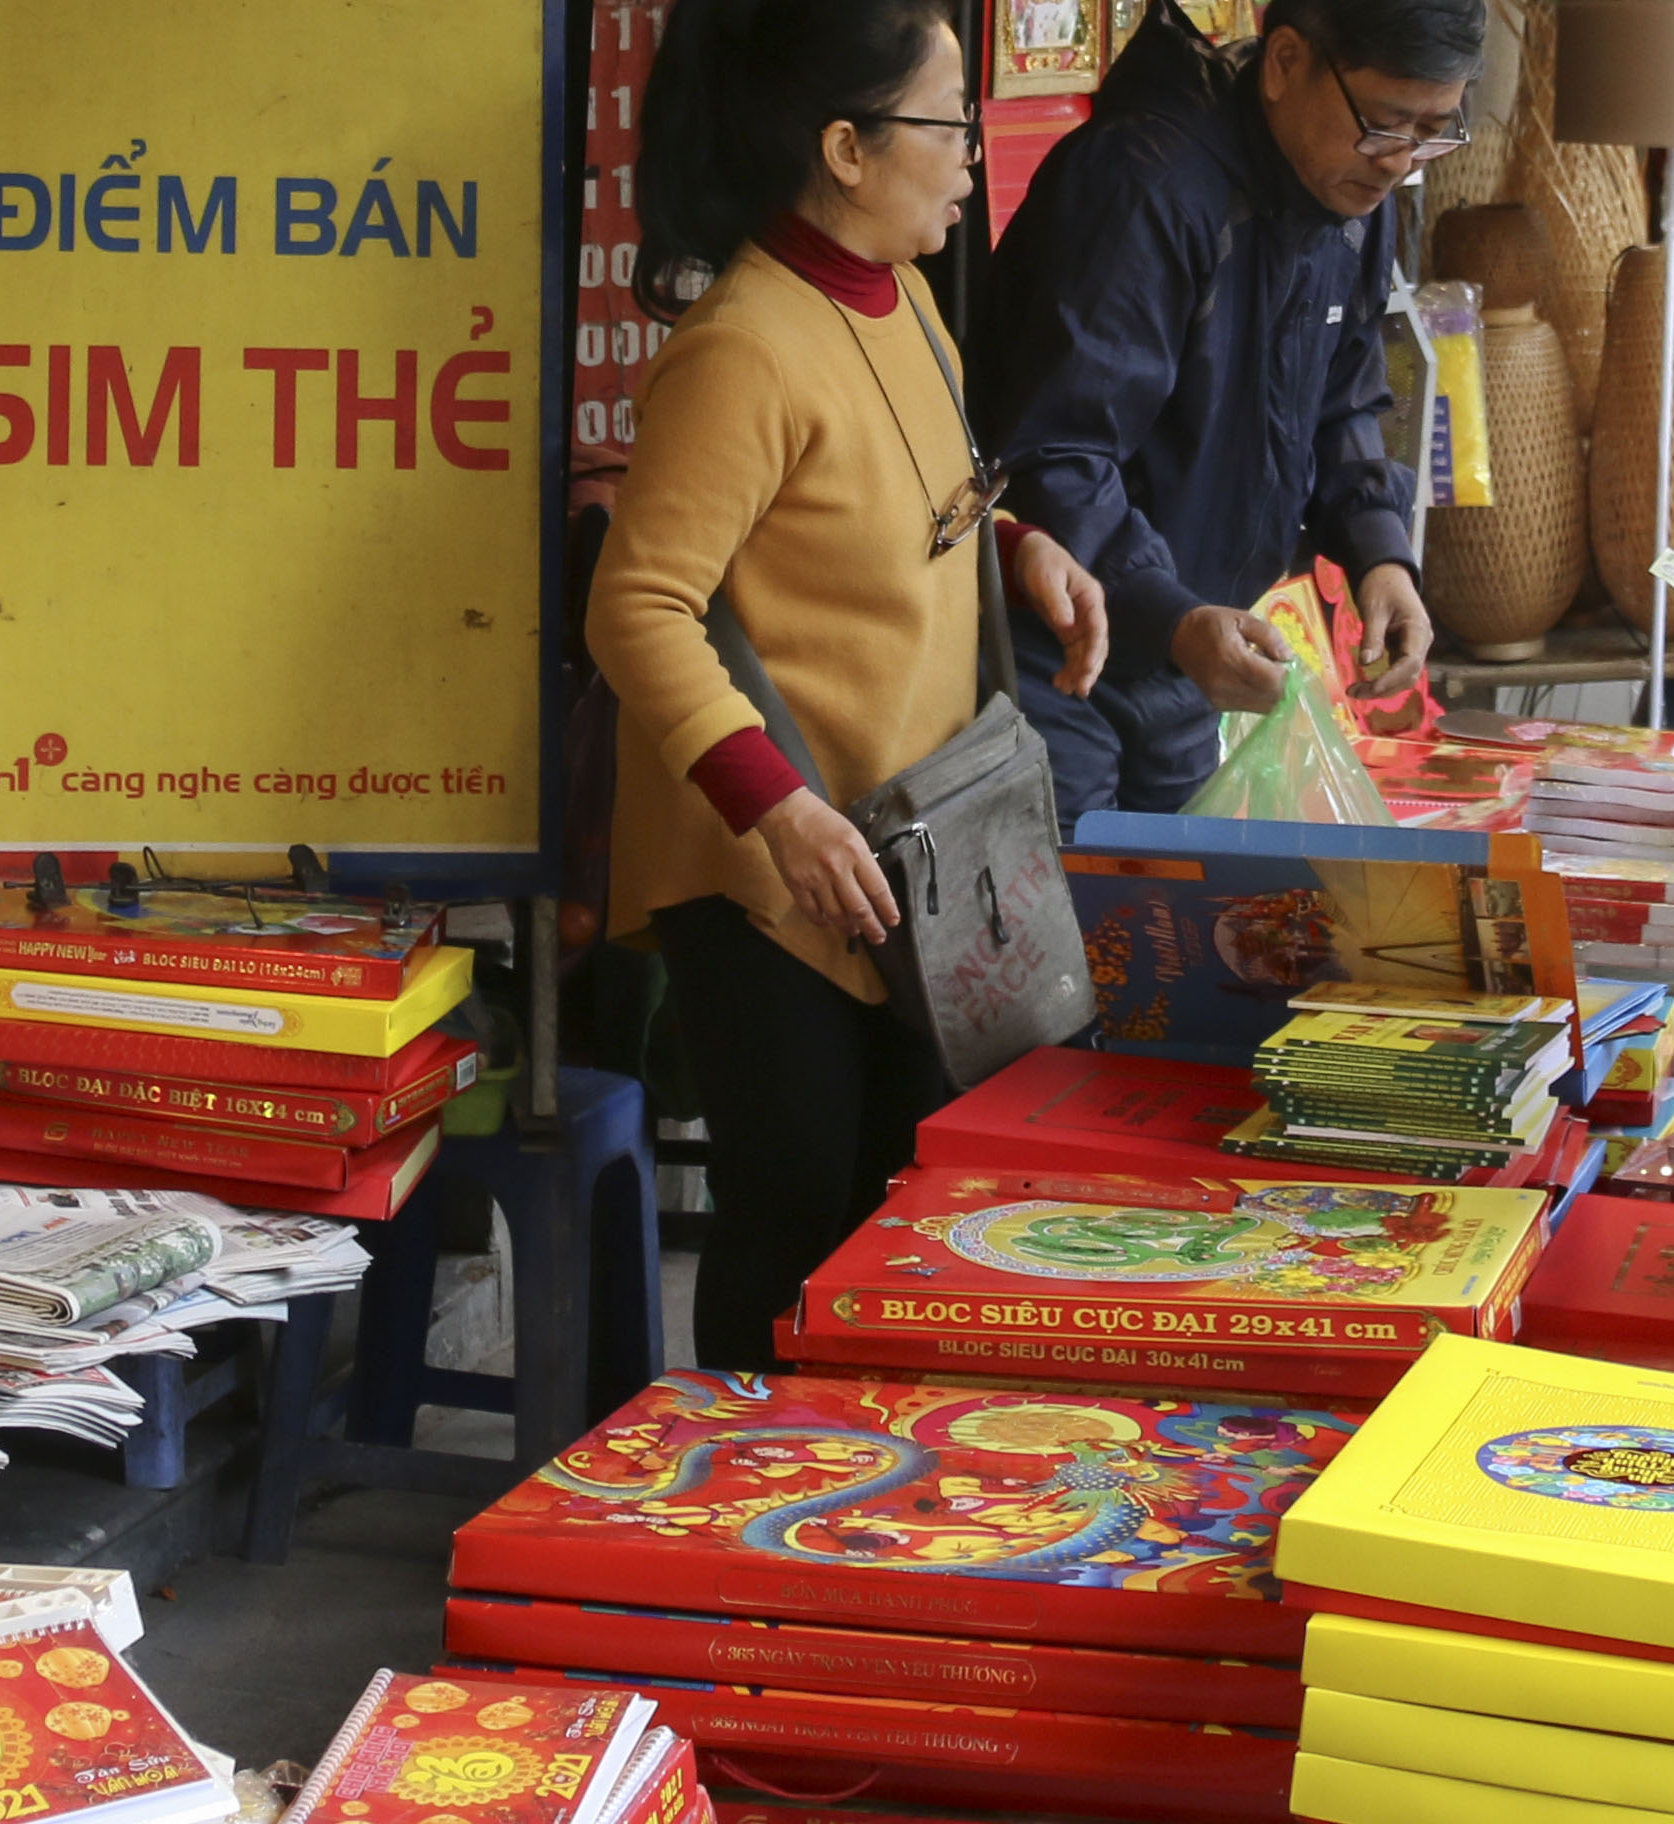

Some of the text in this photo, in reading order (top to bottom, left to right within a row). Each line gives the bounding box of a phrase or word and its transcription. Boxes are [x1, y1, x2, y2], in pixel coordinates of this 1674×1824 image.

[274, 157, 479, 260] BÁN
[242, 305, 512, 472] THẺ
[60, 770, 146, 800] càng
[156, 767, 241, 801] nghe
[253, 768, 336, 801] càng
[348, 764, 432, 802] được
[440, 763, 507, 796] tiền
[18, 940, 56, 958] HAPPY
[56, 943, 87, 960] NEW
[142, 952, 176, 968] BLOC
[17, 1067, 326, 1126] BLOC ĐẠI ĐẶC BIỆT 16X24 cm
[881, 1298, 1398, 1341] BLOC SIÊU CỰC ĐẠI 29x41 cm
[937, 1338, 994, 1359] BLOC
[1145, 1350, 1209, 1371] 30x41
[1211, 1356, 1246, 1373] cm
[727, 1645, 756, 1662] 365
[939, 1663, 1016, 1685] THƯƠNG
[534, 1753, 596, 1802] 2021
